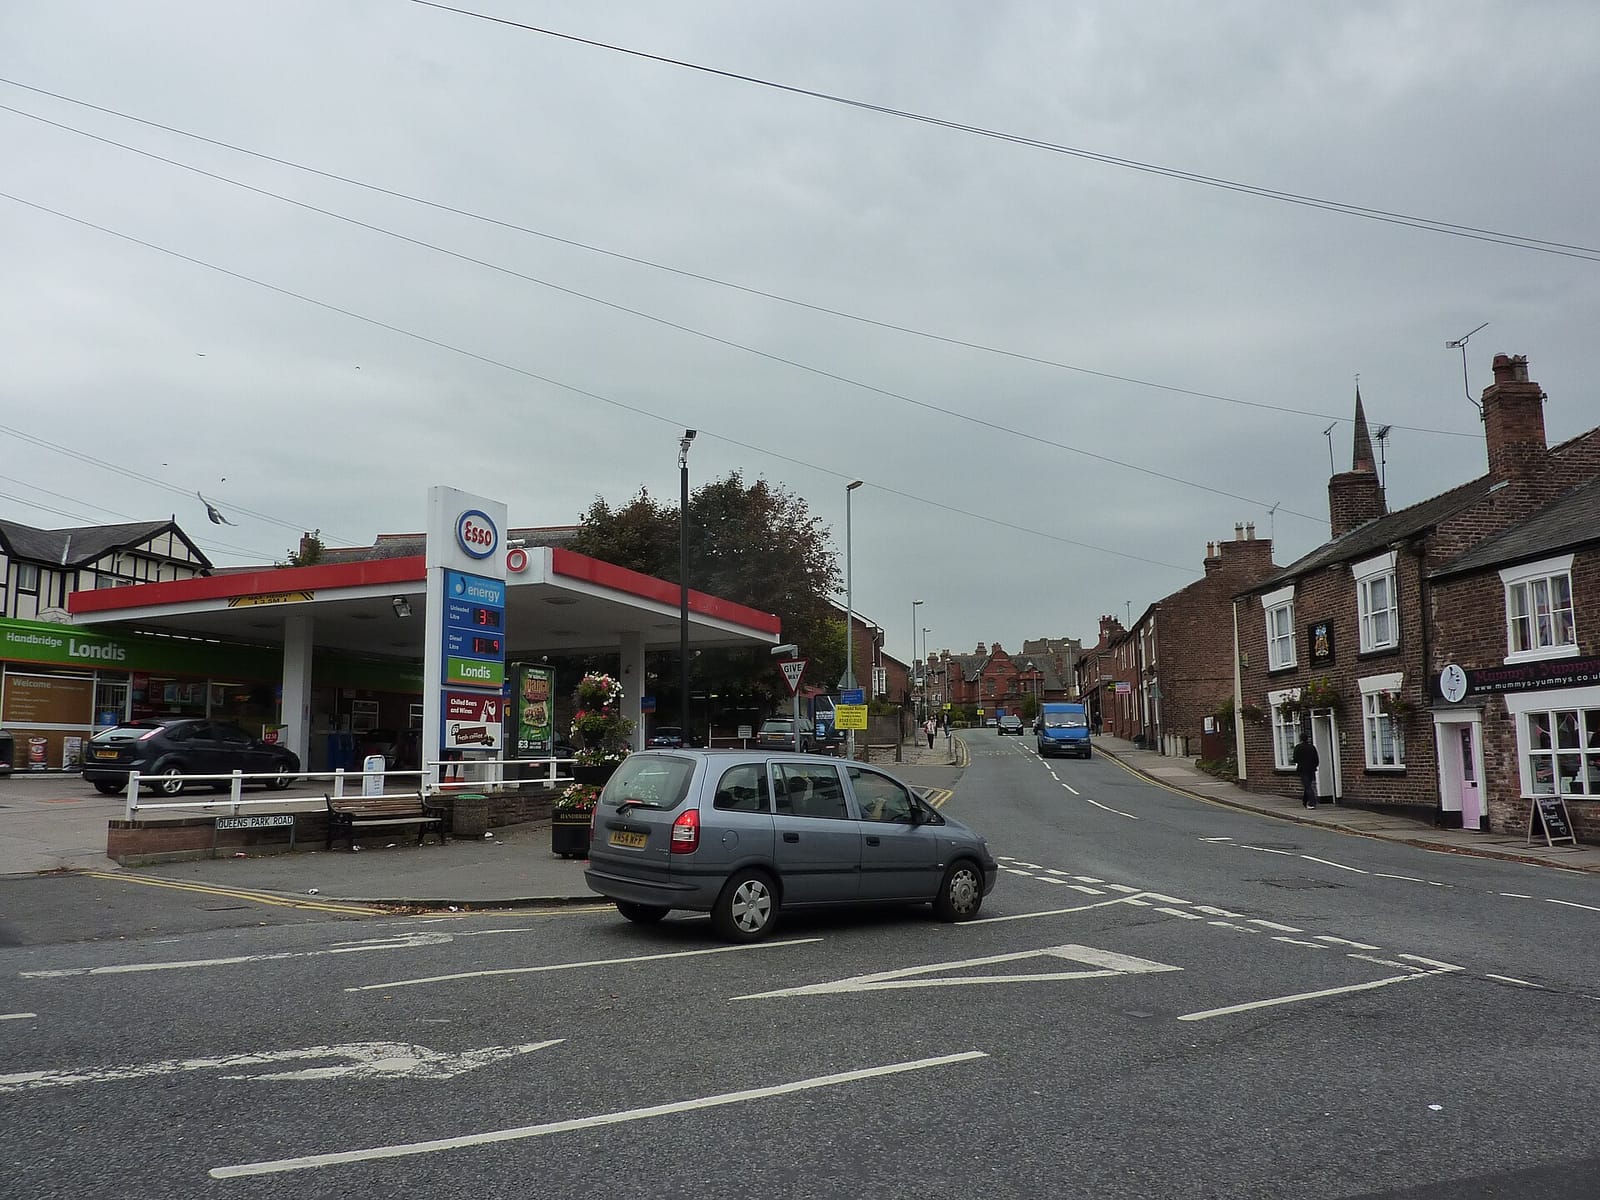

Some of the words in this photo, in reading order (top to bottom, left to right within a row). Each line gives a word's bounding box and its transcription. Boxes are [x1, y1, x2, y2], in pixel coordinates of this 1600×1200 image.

[465, 521, 492, 546] Esso
[467, 586, 500, 603] energy
[449, 634, 463, 642] Diesel
[6, 632, 63, 647] Handbridge
[69, 638, 126, 661] Londis
[460, 663, 491, 679] Londis
[784, 664, 802, 672] GIVE
[12, 679, 51, 688] Welcome
[450, 698, 466, 706] Chilled
[218, 818, 248, 829] QUEENS
[251, 817, 270, 827] PARK
[273, 816, 293, 825] ROAD
